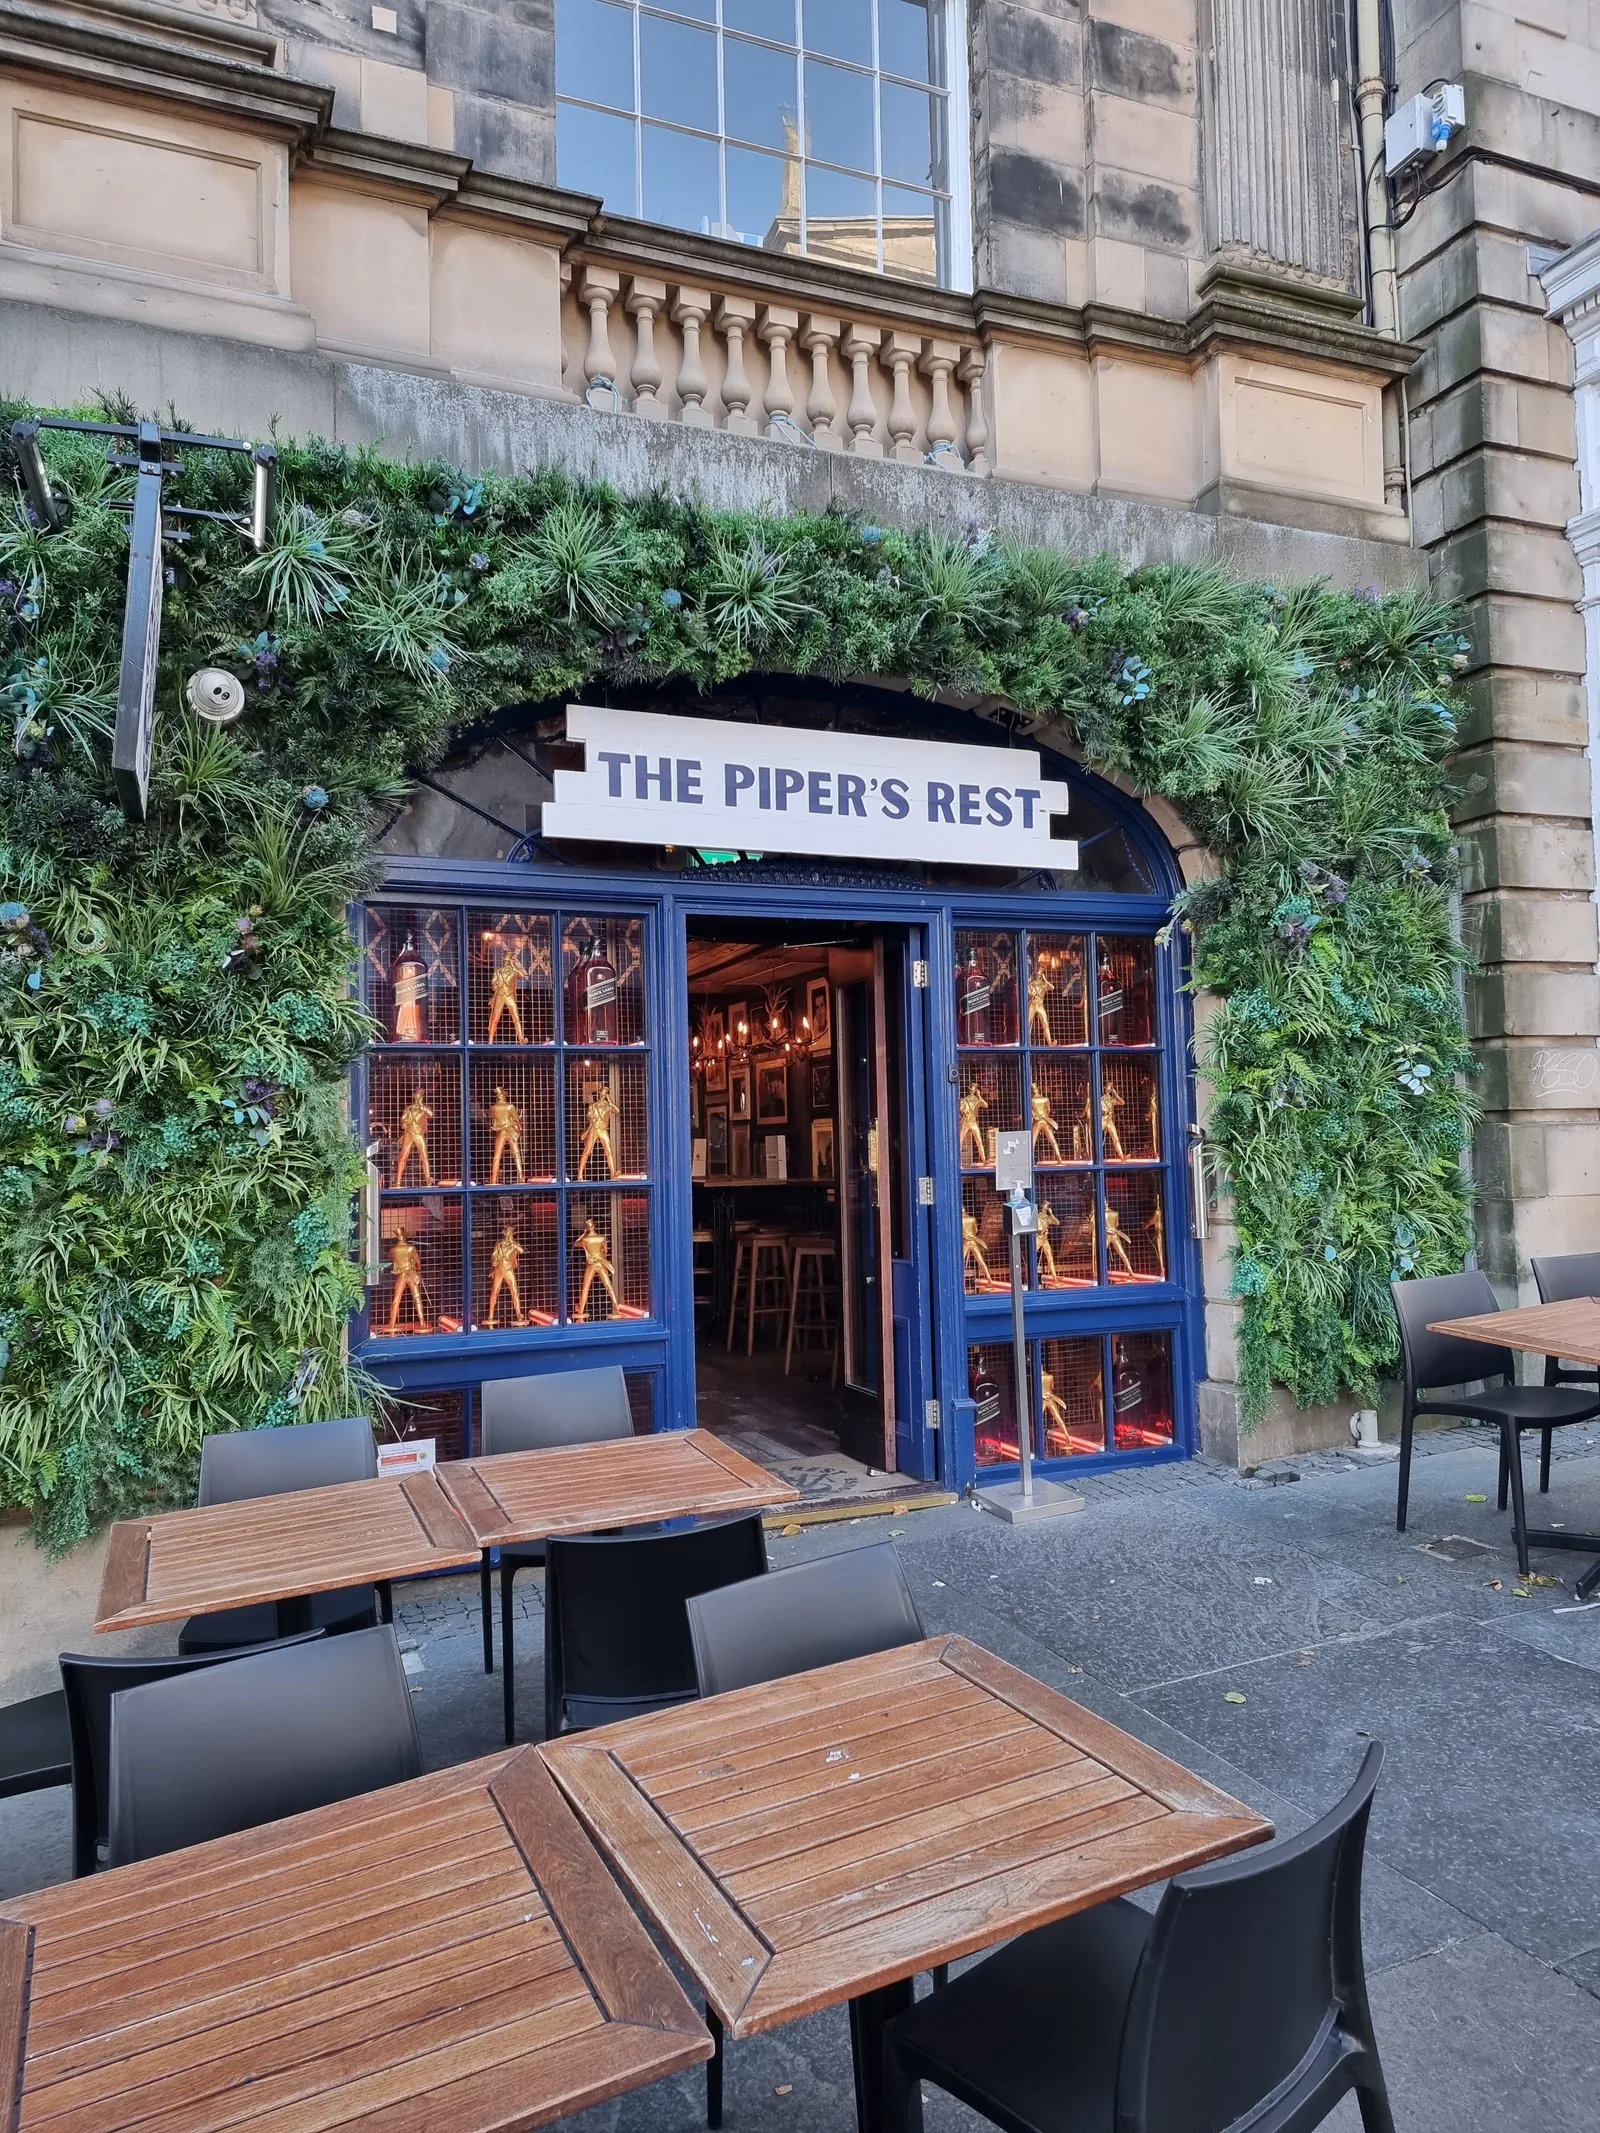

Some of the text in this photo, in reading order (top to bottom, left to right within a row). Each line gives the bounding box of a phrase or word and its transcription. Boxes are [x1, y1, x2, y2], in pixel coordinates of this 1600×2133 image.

[598, 751, 1041, 829] THE PIPER'S REST
[412, 982, 425, 990] LABEL
[602, 986, 615, 994] LABEL
